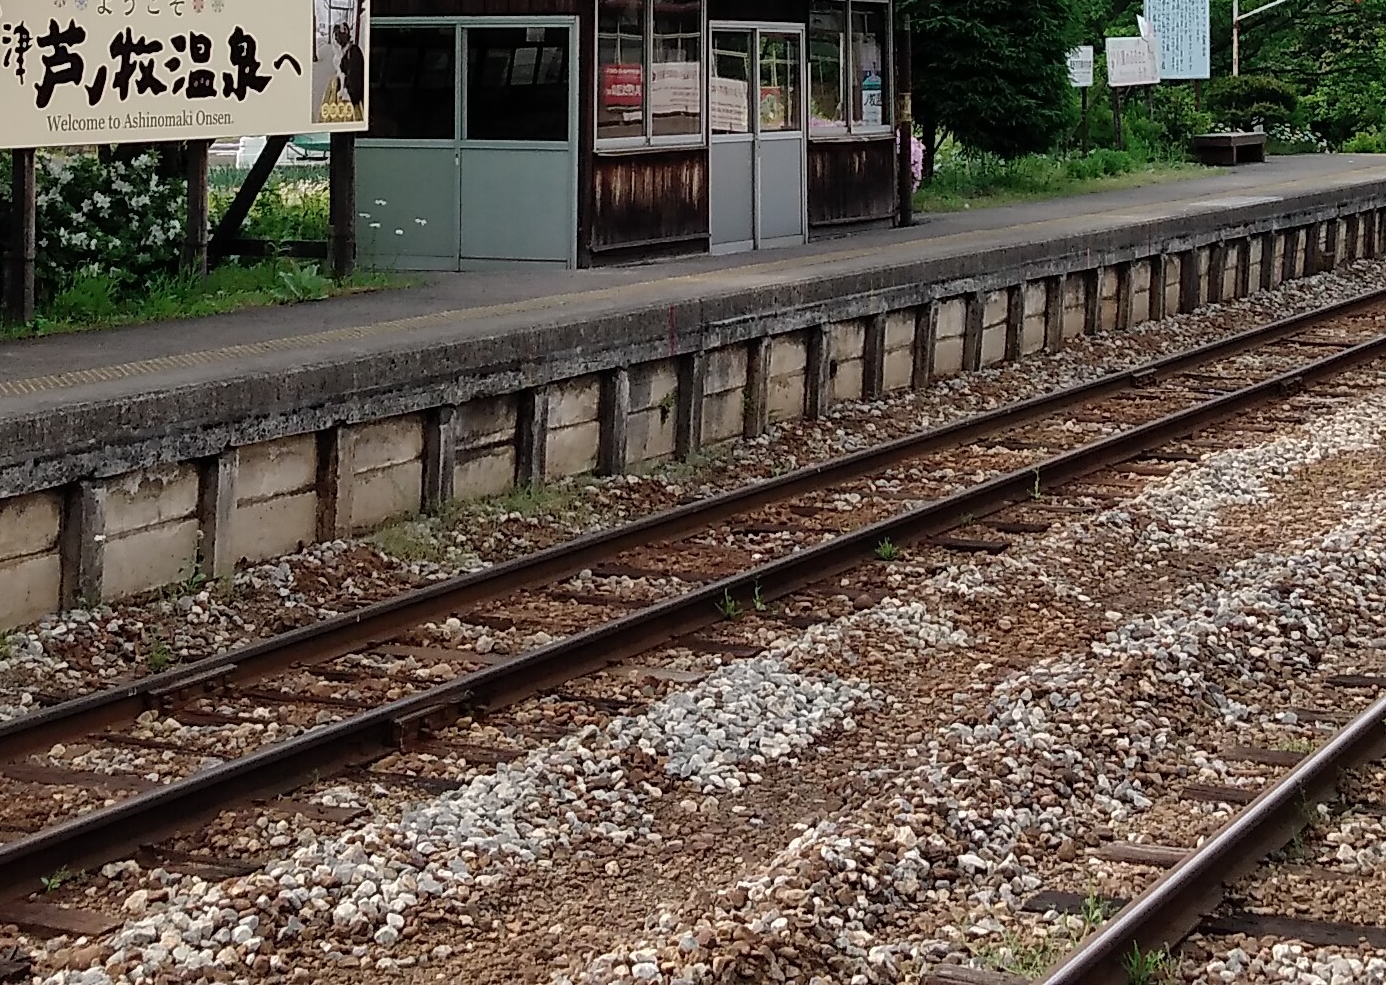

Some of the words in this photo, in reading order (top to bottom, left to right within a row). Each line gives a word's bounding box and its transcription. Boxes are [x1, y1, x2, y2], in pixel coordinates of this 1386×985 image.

[47, 114, 106, 132] Welcome
[108, 116, 121, 130] to
[123, 109, 193, 129] Ashinomaki
[195, 110, 235, 125] Onsen.
